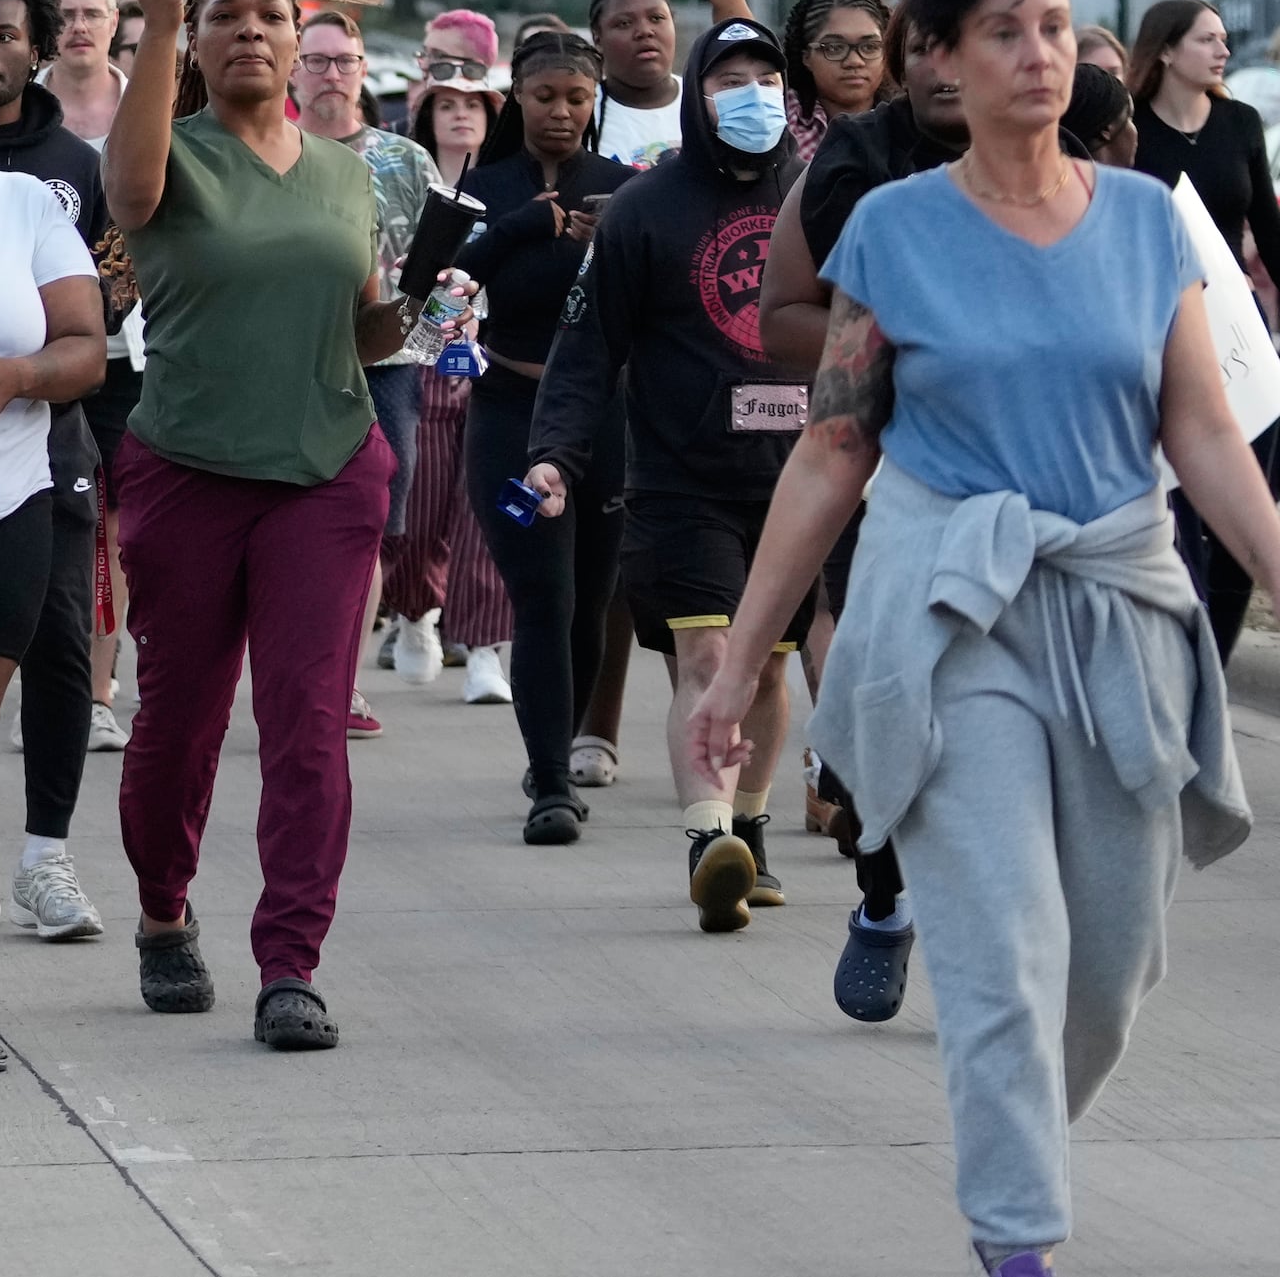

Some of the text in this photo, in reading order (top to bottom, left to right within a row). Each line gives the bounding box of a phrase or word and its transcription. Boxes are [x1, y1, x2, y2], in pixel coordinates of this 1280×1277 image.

[692, 229, 713, 266] INJURY
[729, 205, 752, 221] ONE
[756, 204, 767, 214] IS
[702, 217, 776, 325] INDUSTRIAL WORKER
[741, 398, 799, 418] Faggot
[96, 478, 106, 606] MADISON HOUSING
